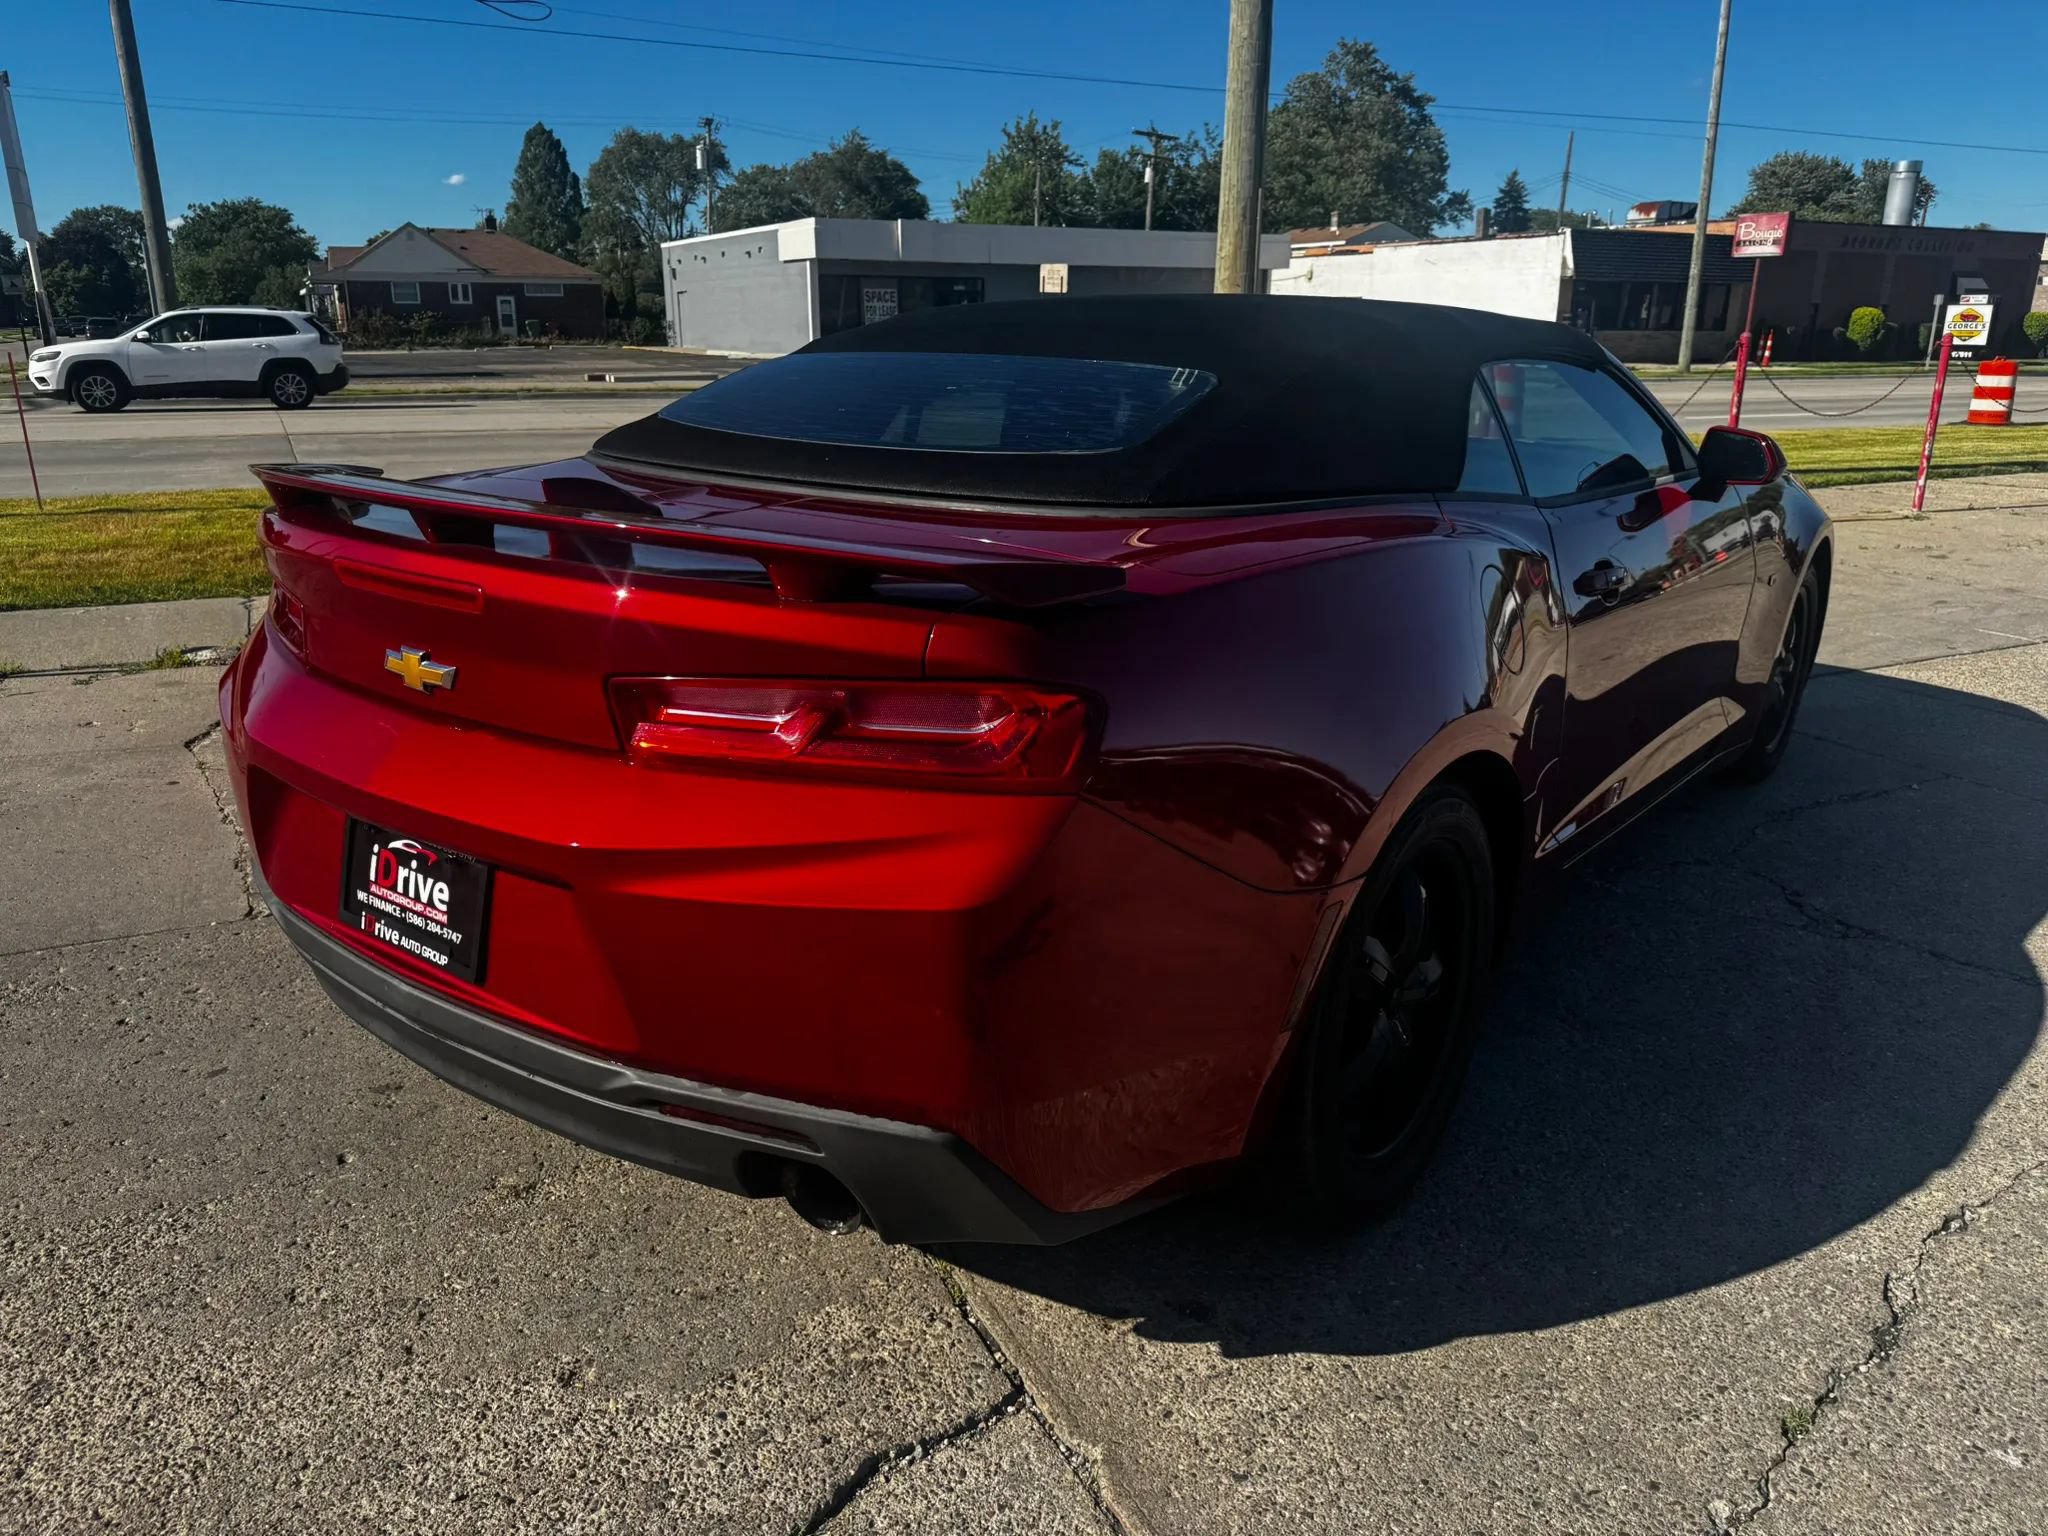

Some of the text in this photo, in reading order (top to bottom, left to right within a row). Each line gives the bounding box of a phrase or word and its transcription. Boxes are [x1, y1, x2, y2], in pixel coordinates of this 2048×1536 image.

[1738, 222, 1783, 246] Bougie
[865, 290, 897, 303] SPACE
[369, 843, 449, 911] iDrive
[357, 889, 462, 945] WE FINANCE (586) 204-5747
[369, 885, 448, 924] AUTOGROUP.COM
[361, 911, 449, 966] iDrive AUTO GROUP
